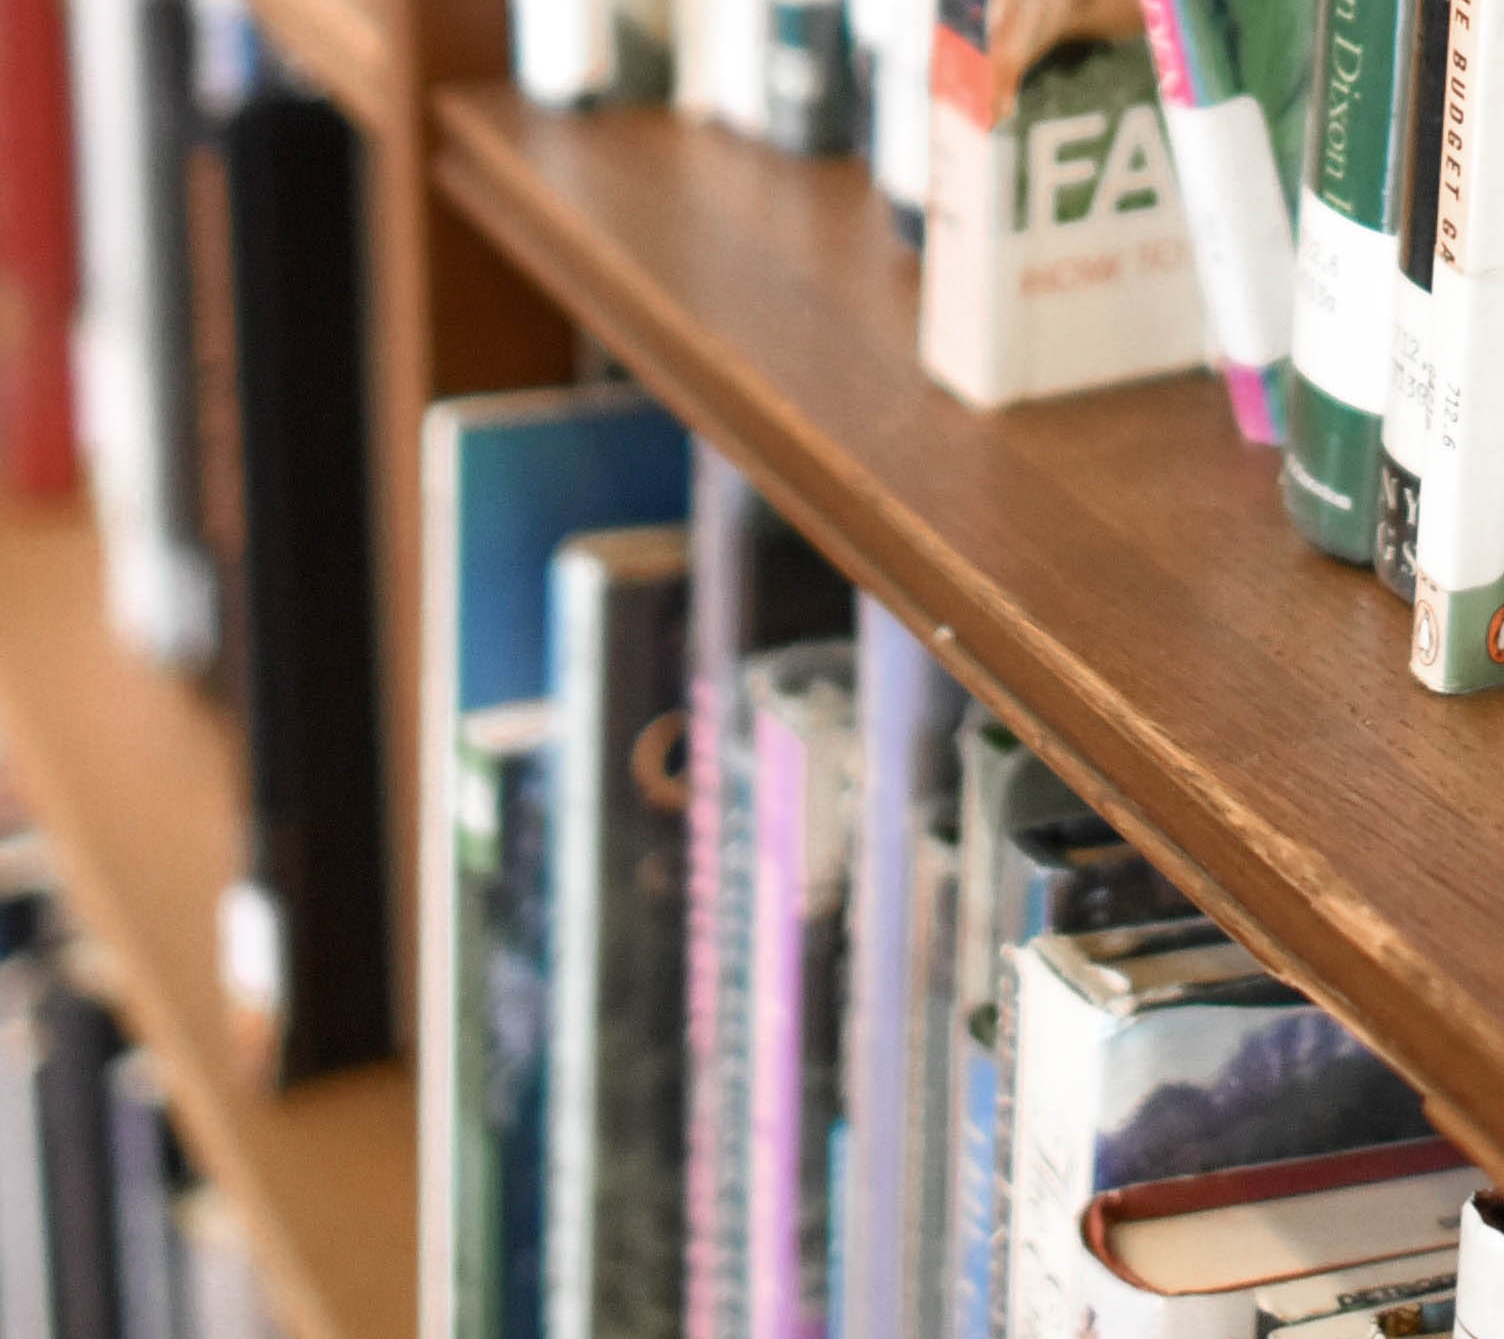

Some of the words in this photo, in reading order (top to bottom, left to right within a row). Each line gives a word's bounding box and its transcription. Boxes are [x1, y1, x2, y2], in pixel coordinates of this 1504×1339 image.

[1325, 31, 1363, 179] Dixon
[1442, 49, 1468, 201] BUDGET
[1442, 380, 1462, 451] 712.6
